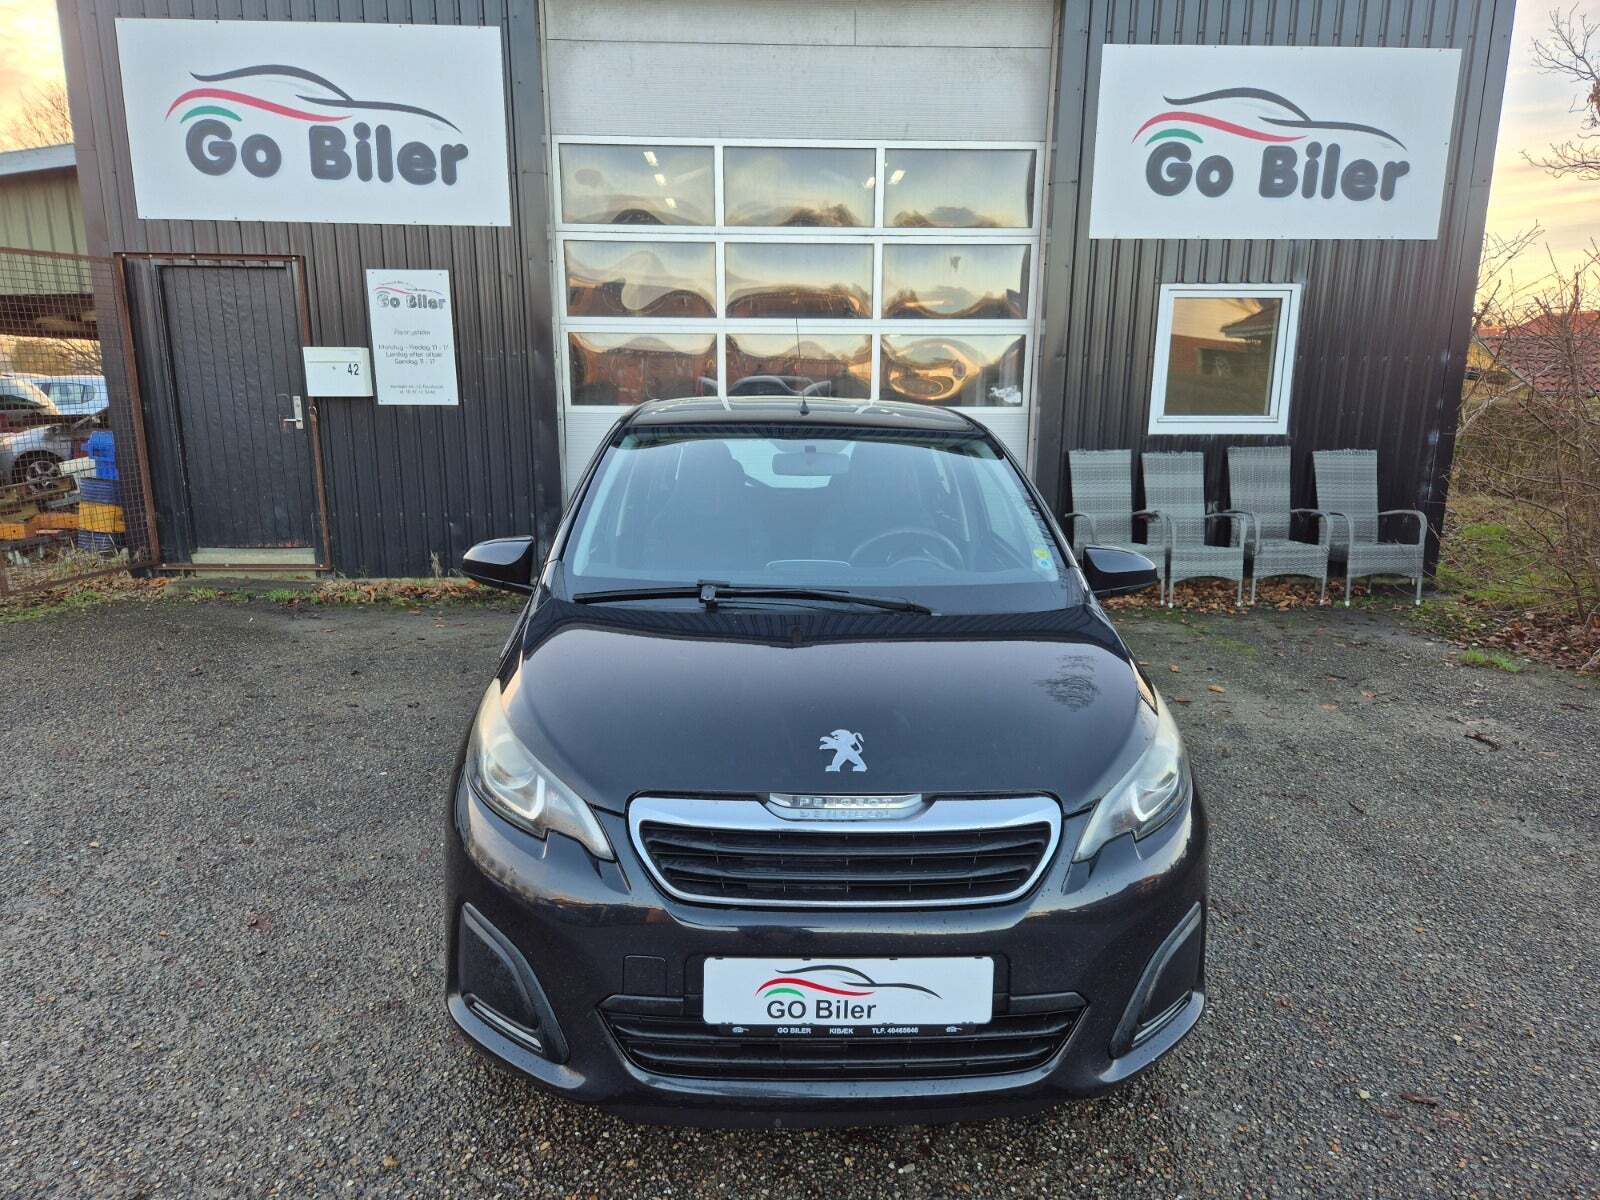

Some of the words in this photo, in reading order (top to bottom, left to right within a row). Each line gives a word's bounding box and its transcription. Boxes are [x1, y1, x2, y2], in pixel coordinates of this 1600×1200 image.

[186, 119, 282, 178] Go
[309, 122, 468, 186] Biler
[1146, 141, 1234, 198] Go
[1258, 141, 1410, 201] Biler
[377, 293, 400, 308] Go
[406, 294, 446, 309] Biler
[347, 363, 360, 376] 42
[766, 1000, 807, 1020] GO
[815, 999, 877, 1020] Biler
